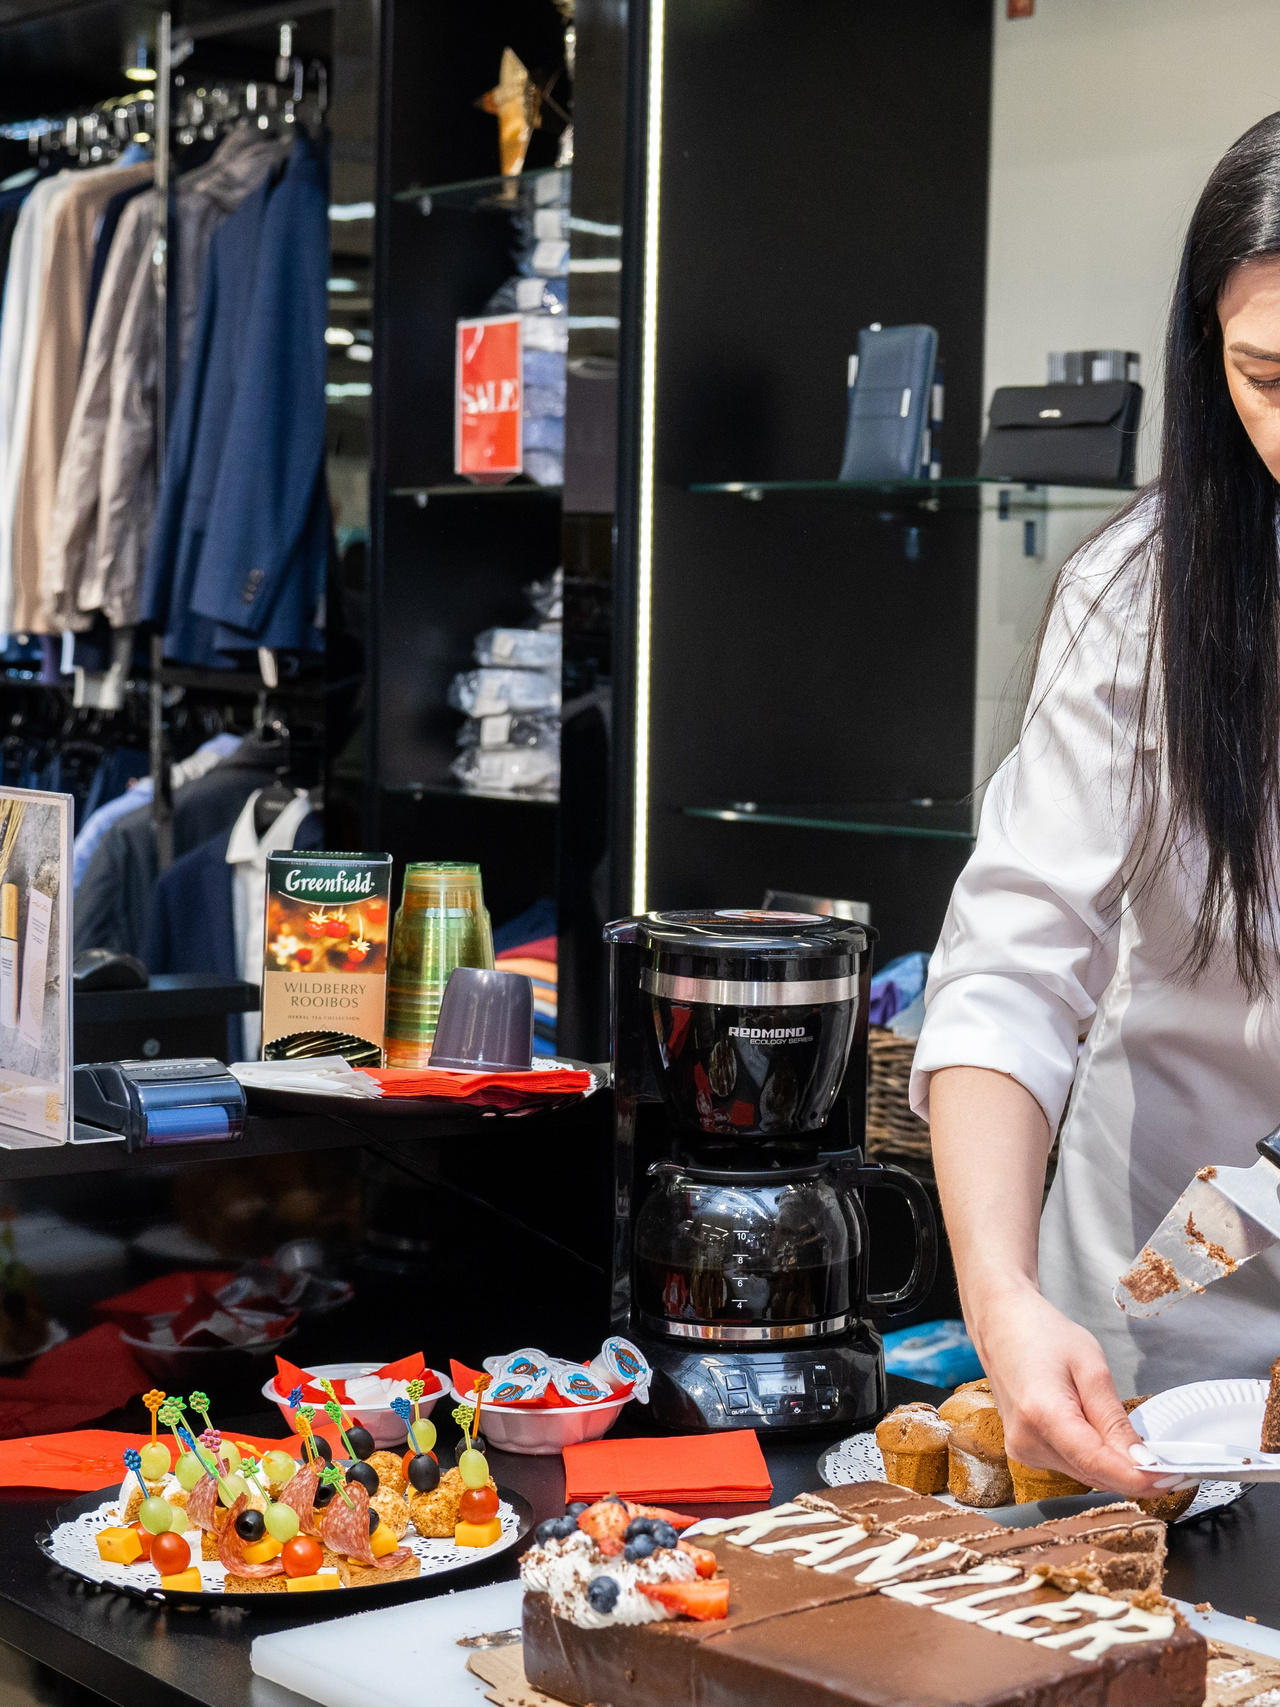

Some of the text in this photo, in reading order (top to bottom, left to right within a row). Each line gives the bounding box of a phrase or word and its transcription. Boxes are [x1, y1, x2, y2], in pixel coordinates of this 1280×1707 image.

[285, 869, 375, 893] Greenfield
[284, 982, 367, 995] WILDBERRY
[291, 996, 359, 1009] ROOIBOS
[788, 1036, 814, 1044] SERIES
[739, 1207, 748, 1215] 12
[737, 1232, 747, 1240] 10
[737, 1256, 744, 1264] 8
[737, 1279, 743, 1287] 6
[736, 1301, 742, 1309] 4
[609, 1342, 647, 1375] СЛИВКИ
[564, 1386, 609, 1398] СЛИВКИ
[698, 1502, 1176, 1661] KANZLER
